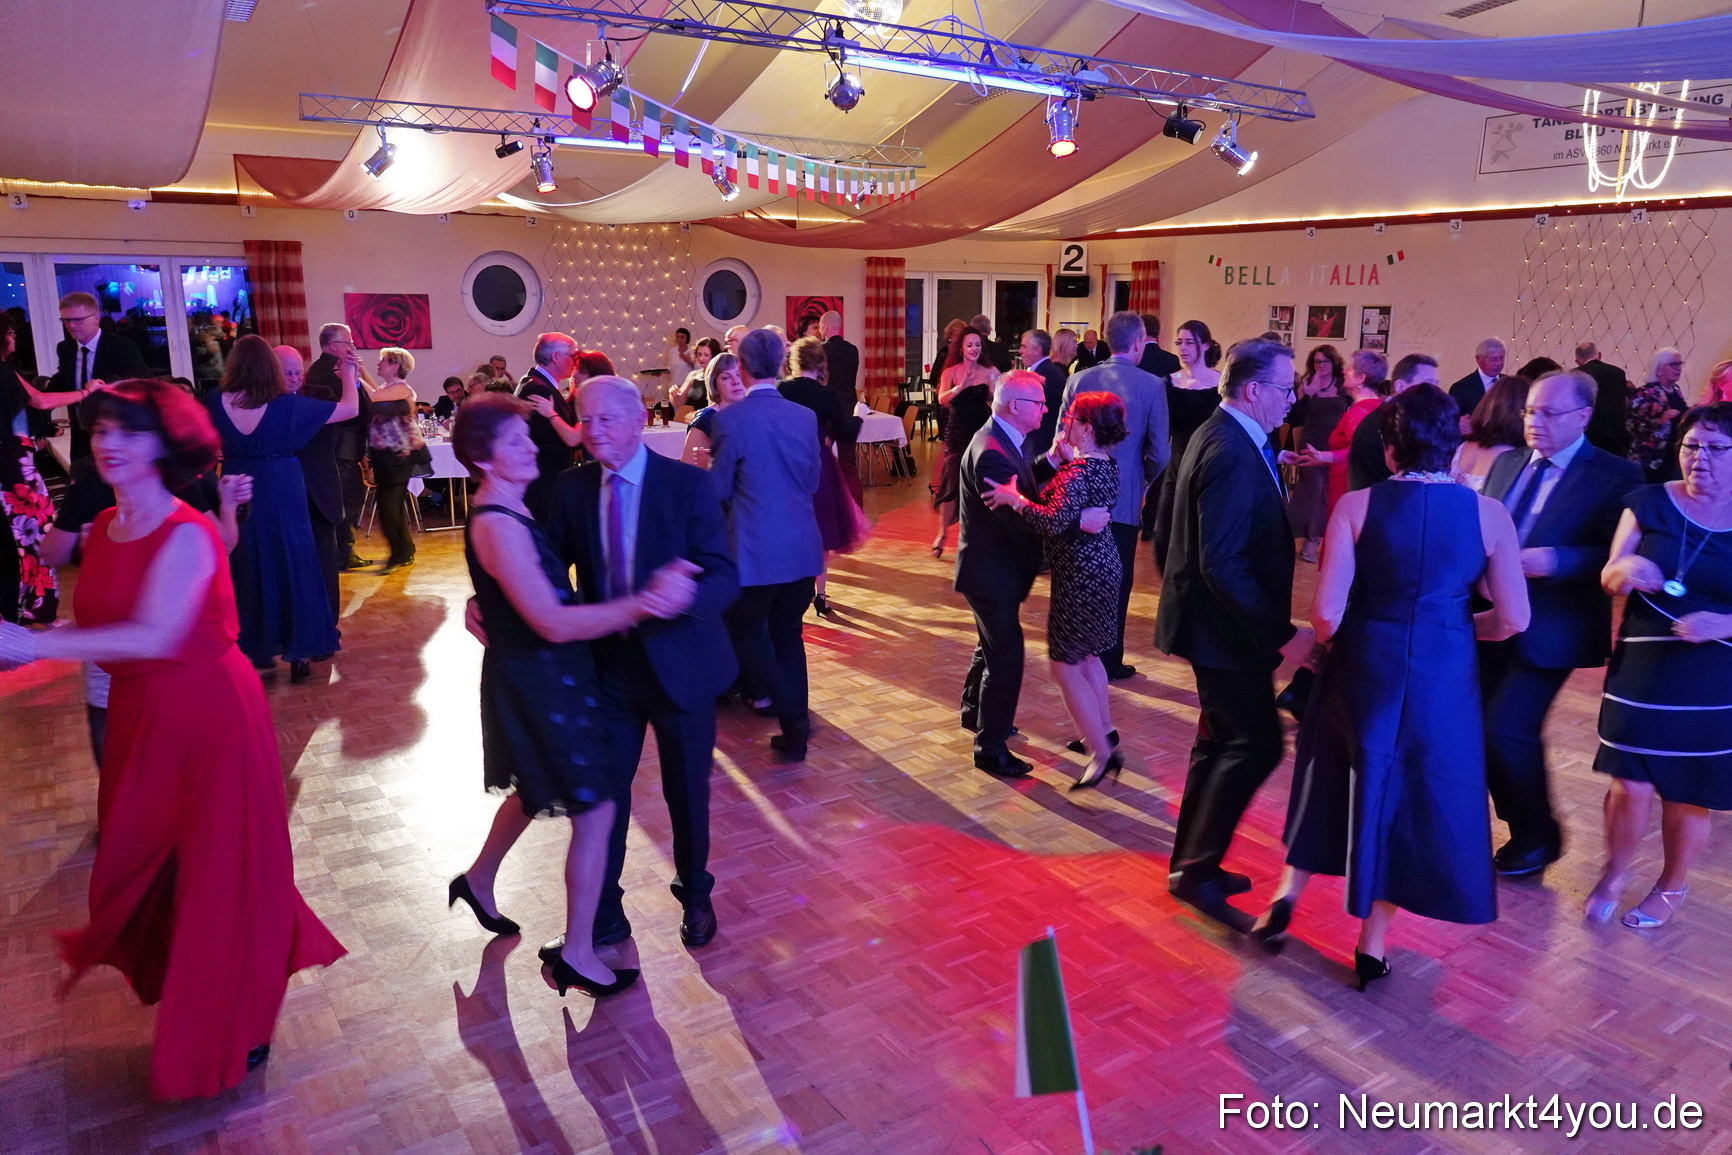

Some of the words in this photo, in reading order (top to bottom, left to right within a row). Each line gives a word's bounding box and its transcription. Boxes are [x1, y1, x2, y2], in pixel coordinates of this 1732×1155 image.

[1553, 150, 1564, 160] im
[14, 195, 22, 206] 3
[133, 200, 141, 210] 2
[246, 206, 251, 214] 1
[349, 209, 354, 219] 0
[440, 213, 448, 221] -1
[528, 217, 537, 225] -2
[1633, 211, 1643, 221] -1
[1375, 225, 1383, 233] -4
[1451, 221, 1460, 230] -3
[1307, 229, 1314, 237] -5
[1063, 244, 1084, 271] 2
[1224, 265, 1290, 286] BELLA
[1309, 263, 1380, 286] ITALIA
